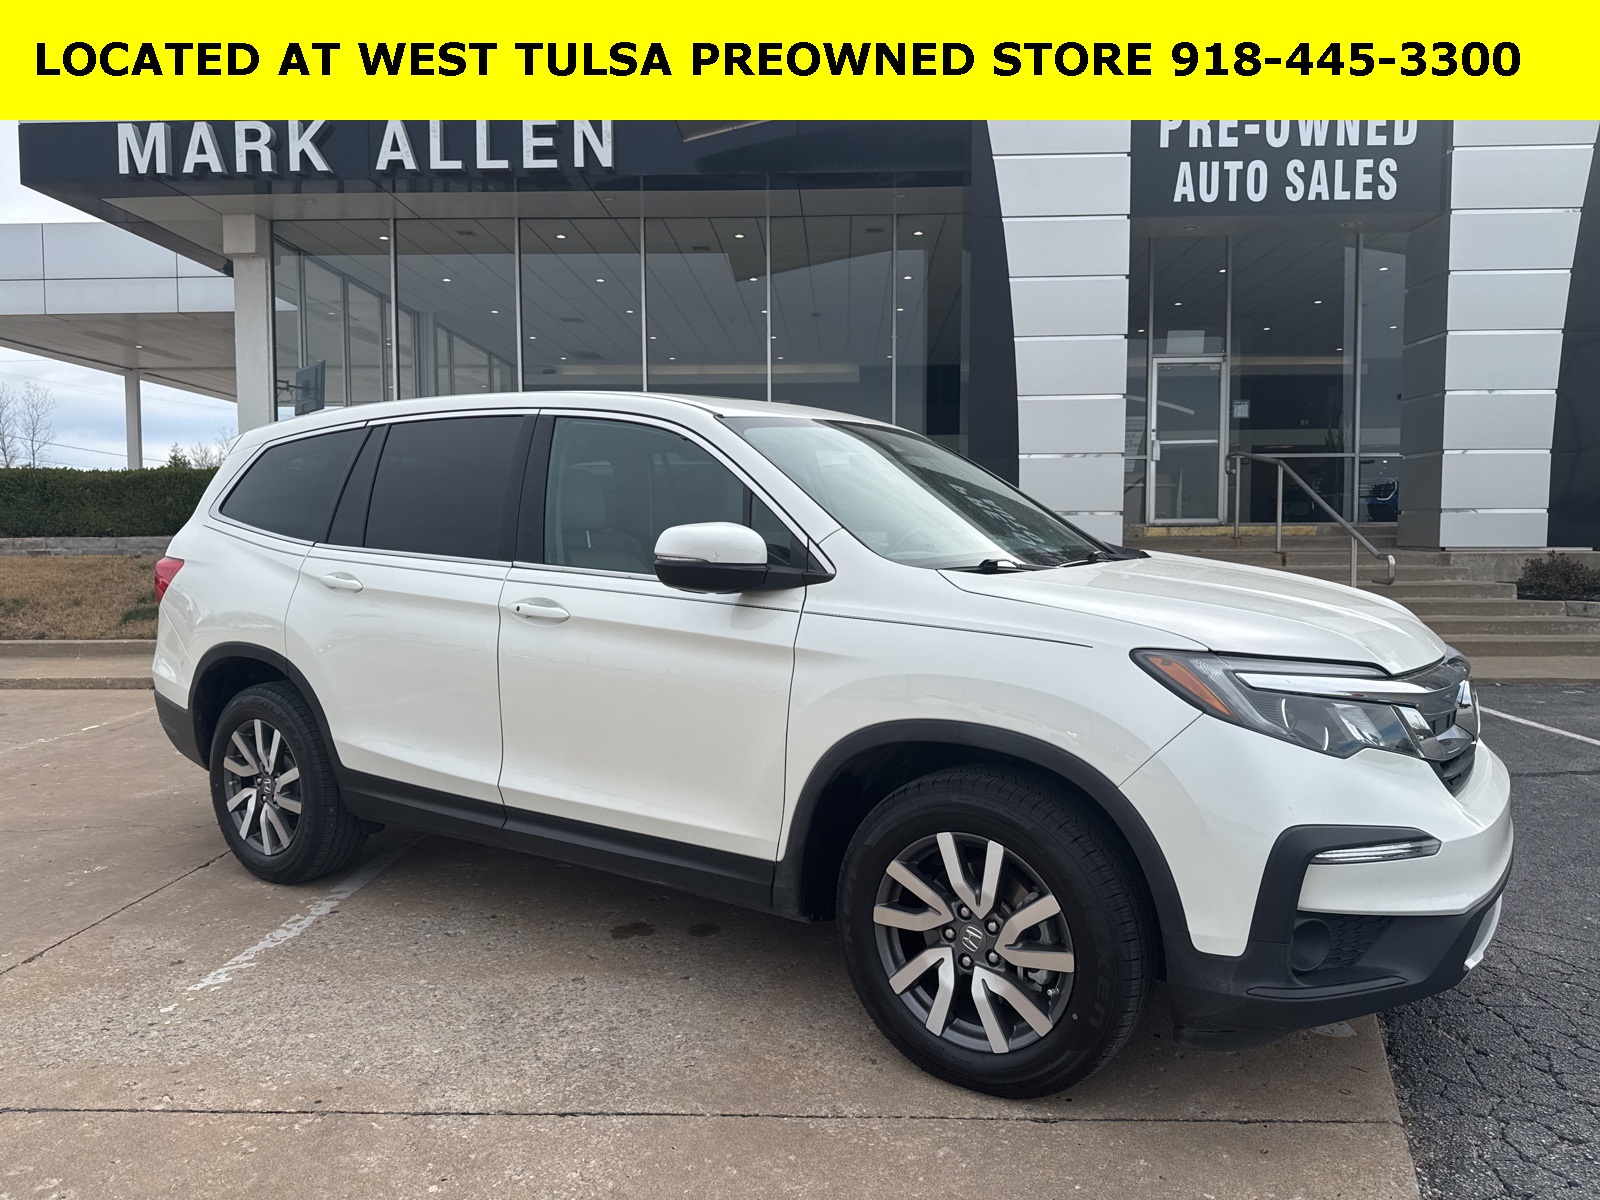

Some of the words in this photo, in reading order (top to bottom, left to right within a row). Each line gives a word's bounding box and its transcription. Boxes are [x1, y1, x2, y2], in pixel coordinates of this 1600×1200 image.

[117, 120, 333, 175] MARK
[375, 120, 615, 172] ALLEN
[1173, 159, 1268, 203] AUTO
[1285, 158, 1398, 202] SALES
